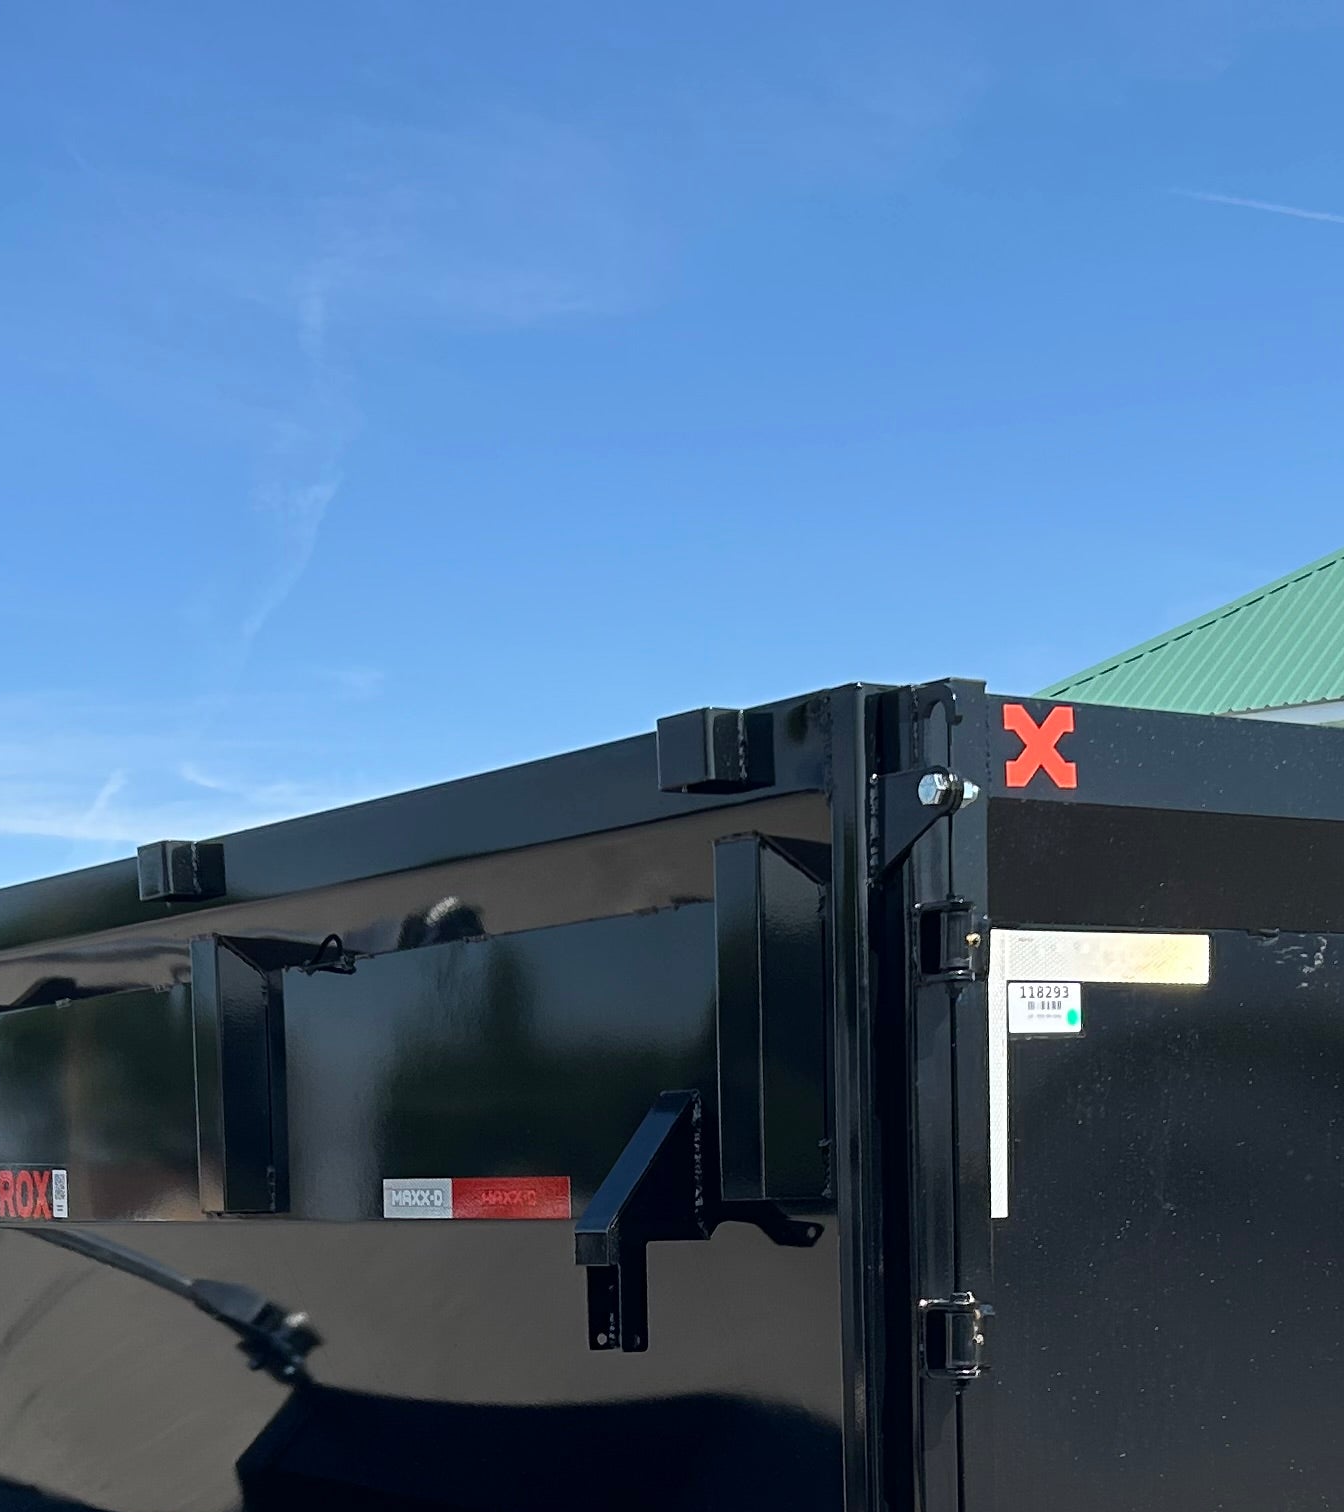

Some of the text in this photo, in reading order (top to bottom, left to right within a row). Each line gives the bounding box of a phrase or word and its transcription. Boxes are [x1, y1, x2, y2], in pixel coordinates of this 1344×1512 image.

[1003, 704, 1077, 789] X
[1020, 985, 1069, 999] 118293
[391, 1190, 443, 1206] MAXX-D
